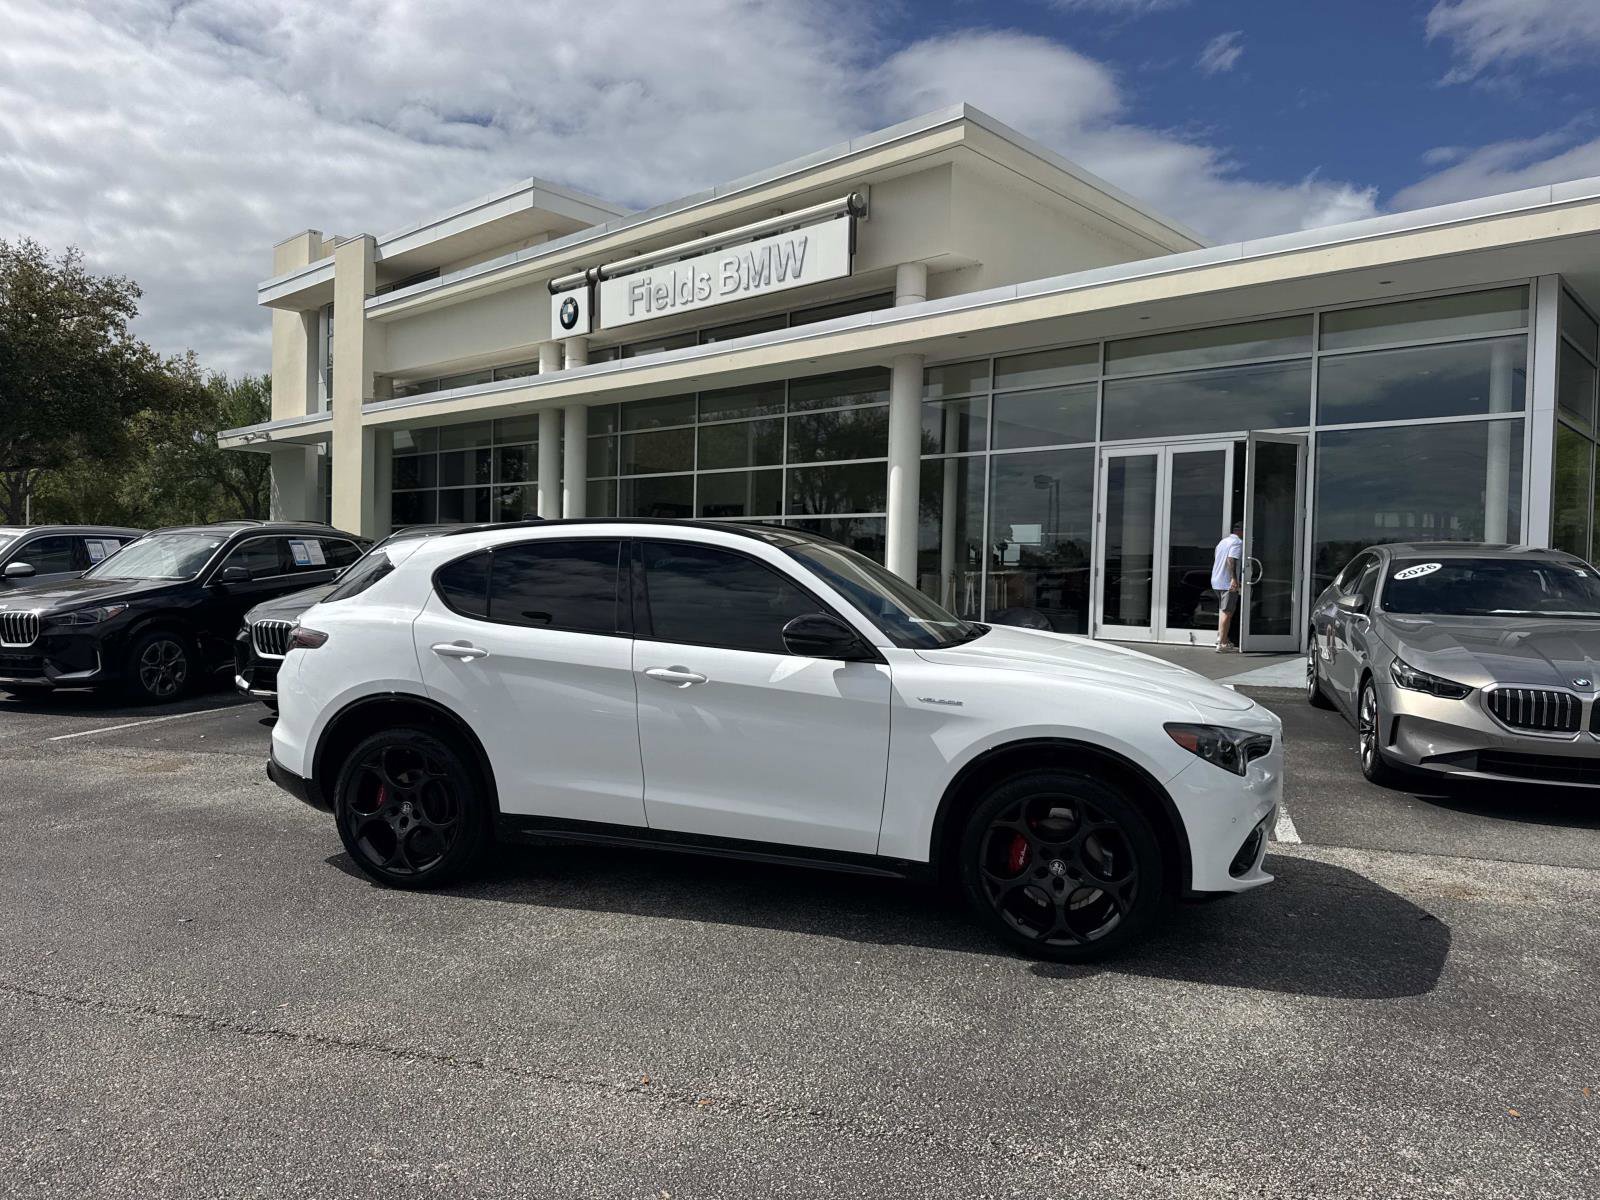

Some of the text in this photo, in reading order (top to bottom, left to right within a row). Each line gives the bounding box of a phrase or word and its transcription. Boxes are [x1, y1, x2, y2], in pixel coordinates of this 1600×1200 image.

[628, 236, 808, 316] Fields BMW
[1398, 564, 1437, 579] 2026
